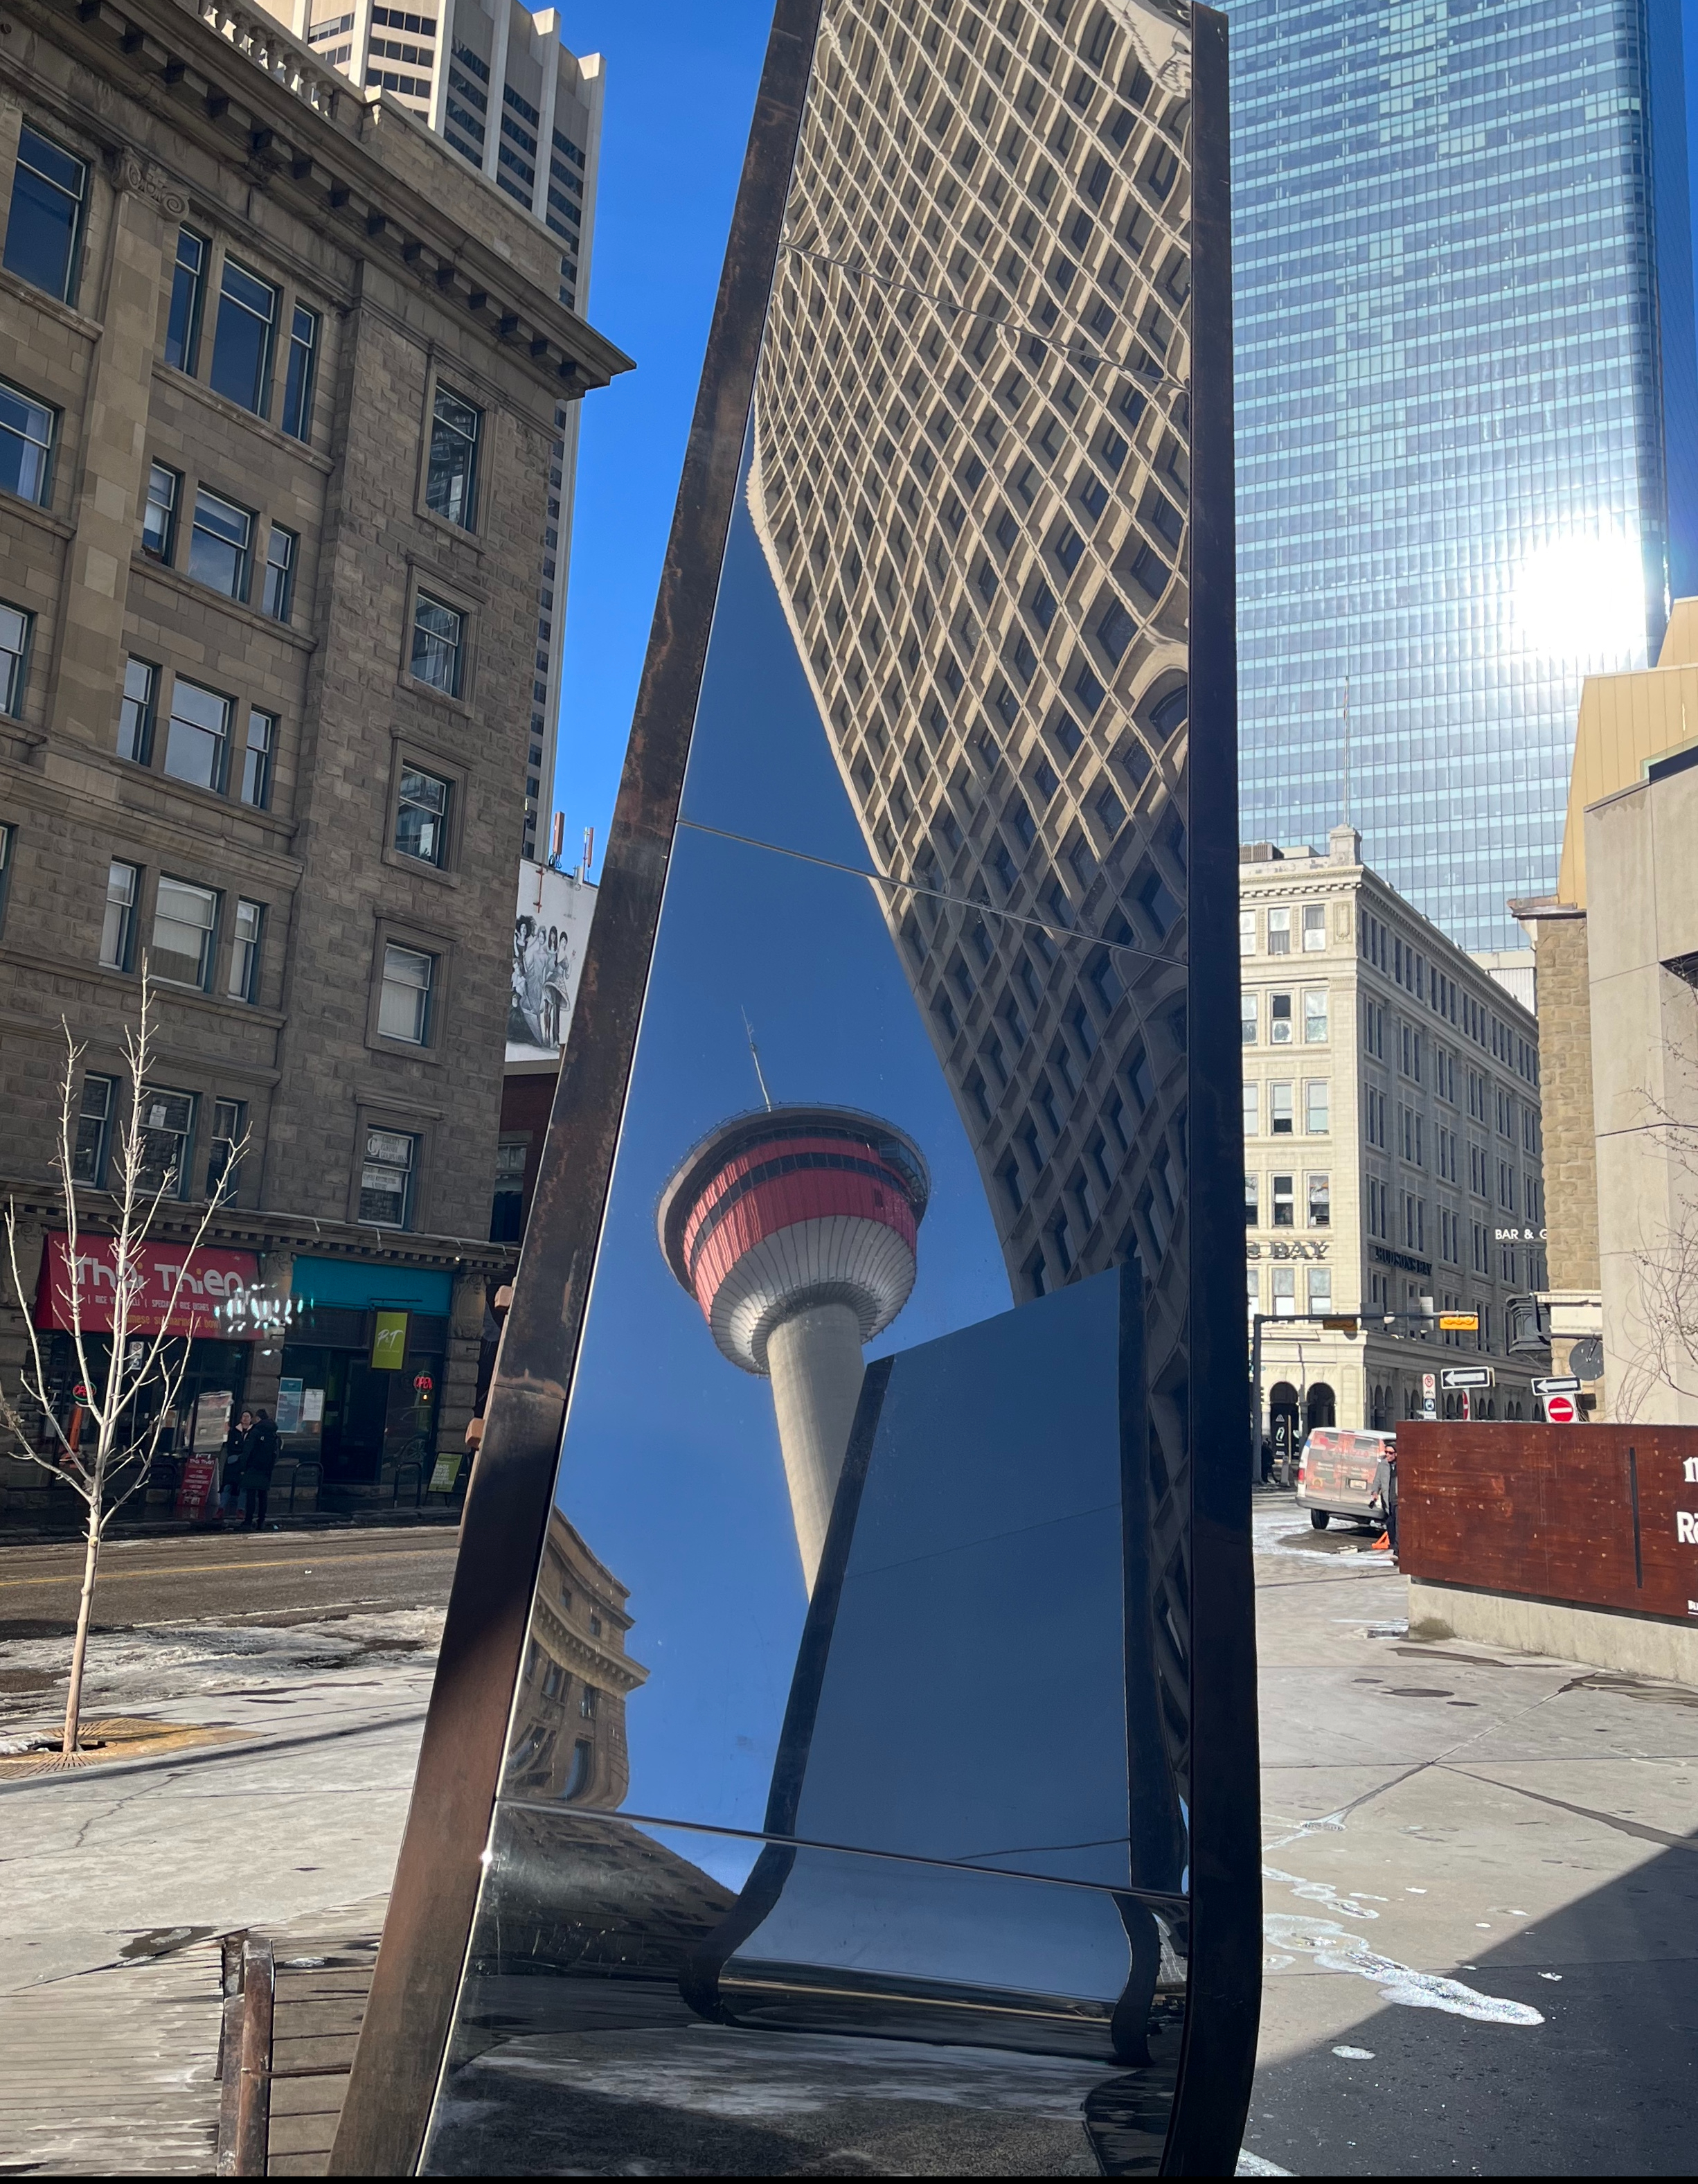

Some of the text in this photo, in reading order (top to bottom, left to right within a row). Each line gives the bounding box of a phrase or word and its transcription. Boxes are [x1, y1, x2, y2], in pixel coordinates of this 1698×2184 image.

[1495, 1229, 1519, 1240] BAR
[1524, 1229, 1534, 1240] &
[1269, 1241, 1329, 1259] BAY
[75, 1257, 244, 1297] Thai Thien
[413, 1376, 433, 1390] OPEN
